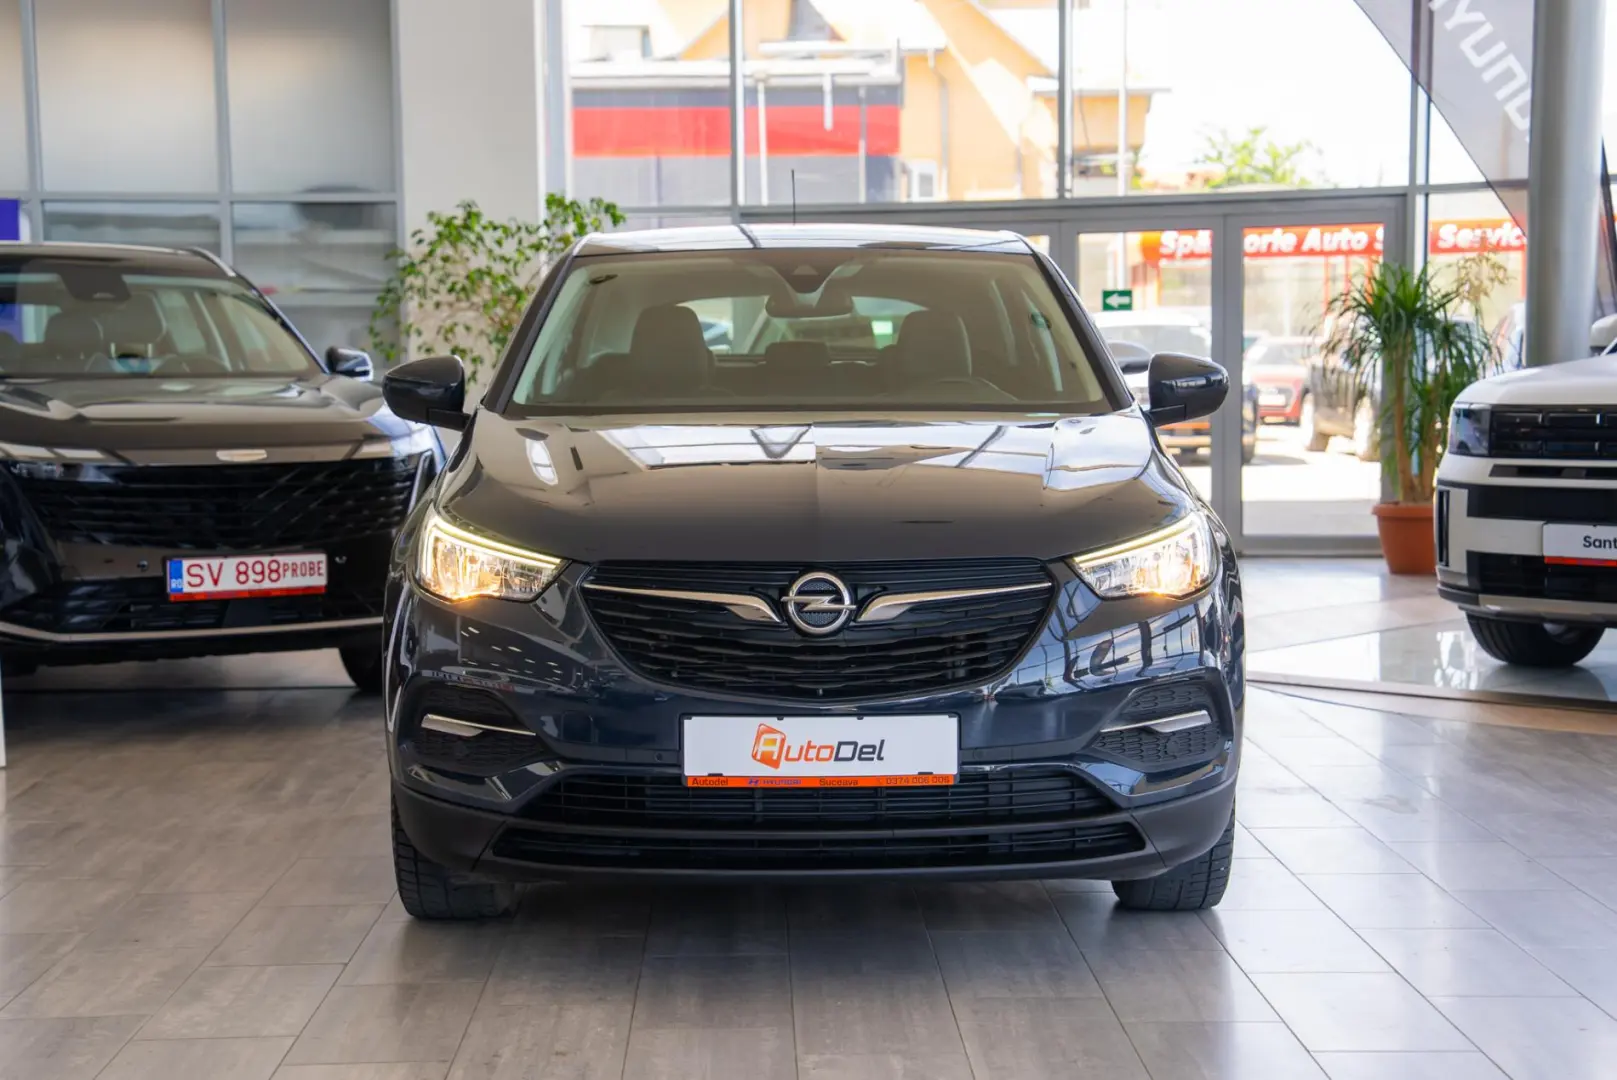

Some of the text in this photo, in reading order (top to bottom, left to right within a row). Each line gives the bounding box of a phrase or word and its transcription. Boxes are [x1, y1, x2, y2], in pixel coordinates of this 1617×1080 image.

[1428, 0, 1531, 142] YUND
[1302, 227, 1368, 251] Auto
[1437, 222, 1528, 249] Servic
[186, 559, 324, 588] SV 898 PROBE
[752, 723, 885, 769] AutoDel
[691, 778, 729, 786] Autodel
[819, 778, 859, 786] Suceava
